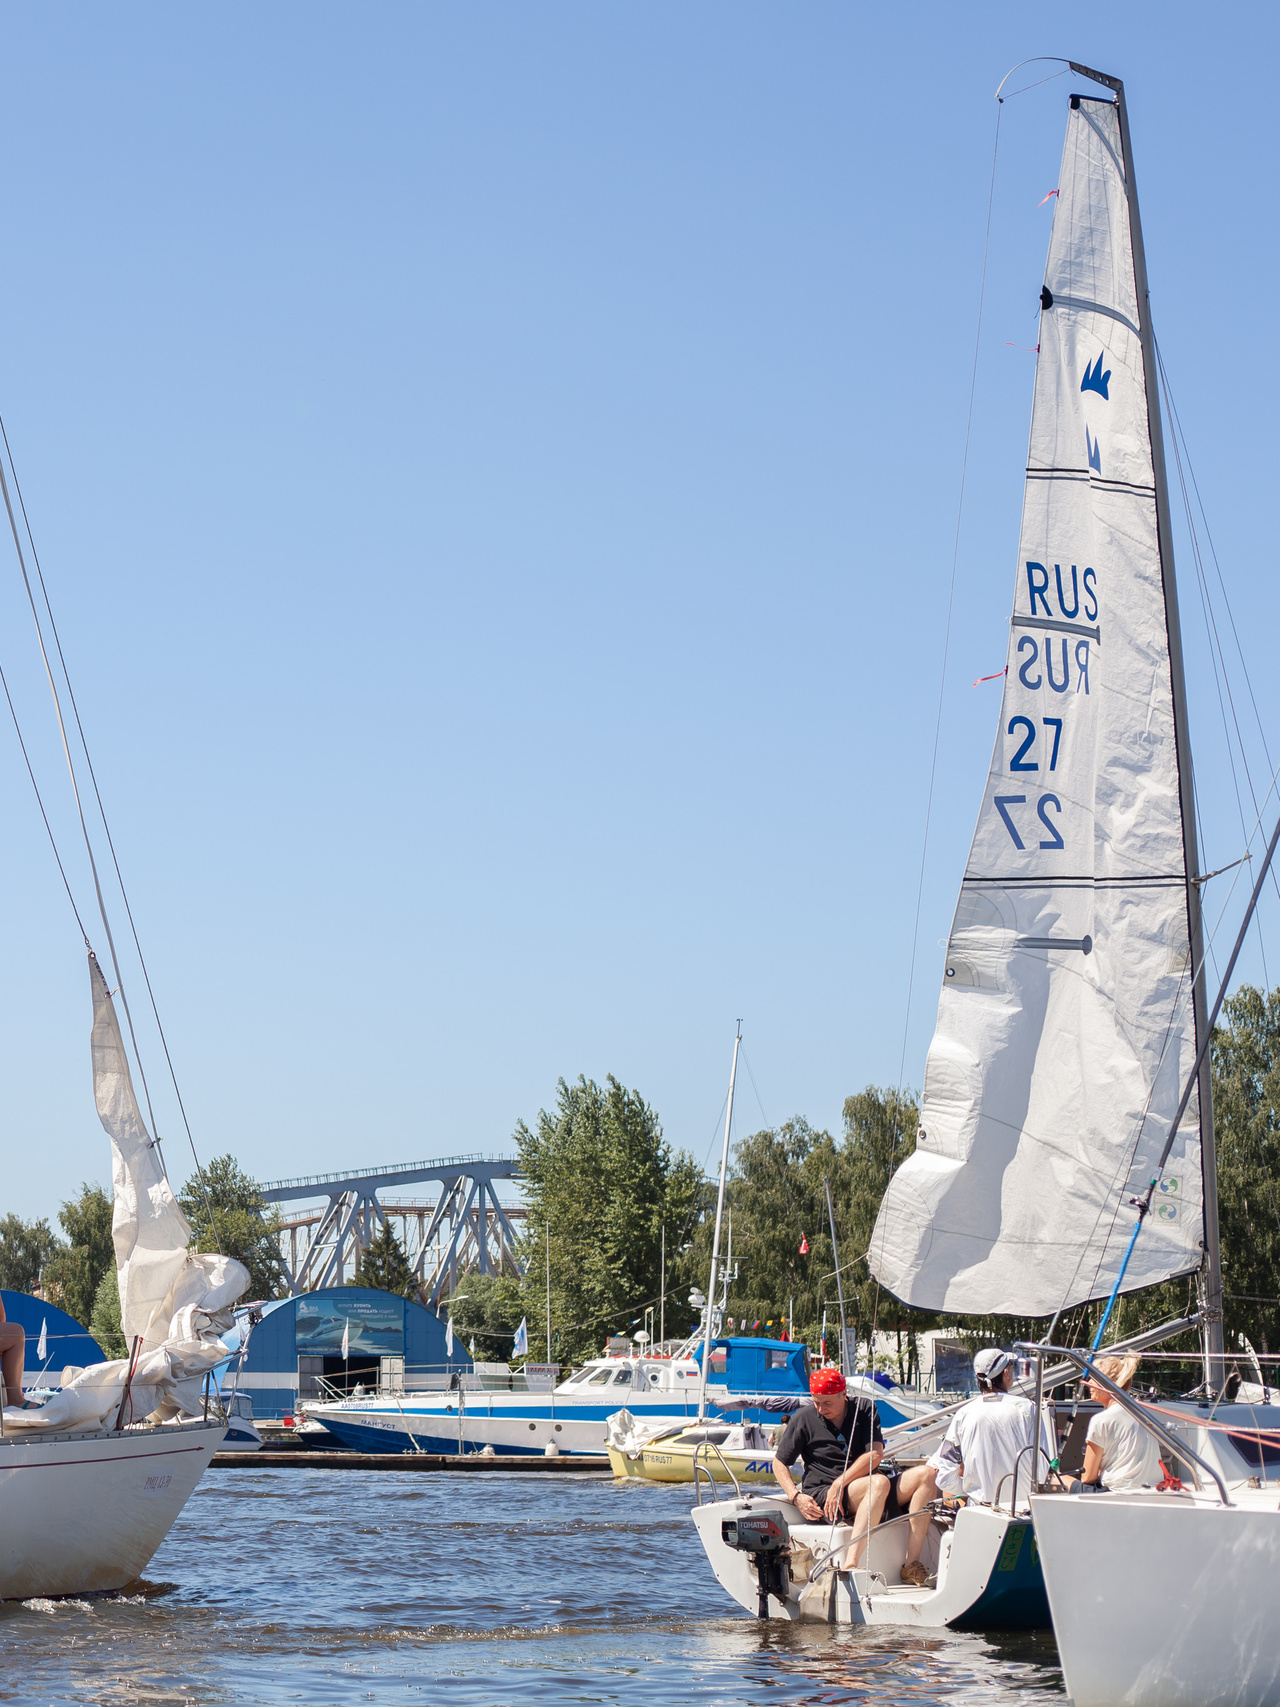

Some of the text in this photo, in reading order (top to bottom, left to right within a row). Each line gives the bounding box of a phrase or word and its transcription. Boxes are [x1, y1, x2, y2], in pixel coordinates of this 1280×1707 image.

[1026, 561, 1098, 622] RUS
[1007, 715, 1063, 772] 27
[361, 1419, 396, 1430] МАНГУСТ
[739, 1521, 769, 1529] TOHATSU
[1001, 1527, 1024, 1570] わさび
